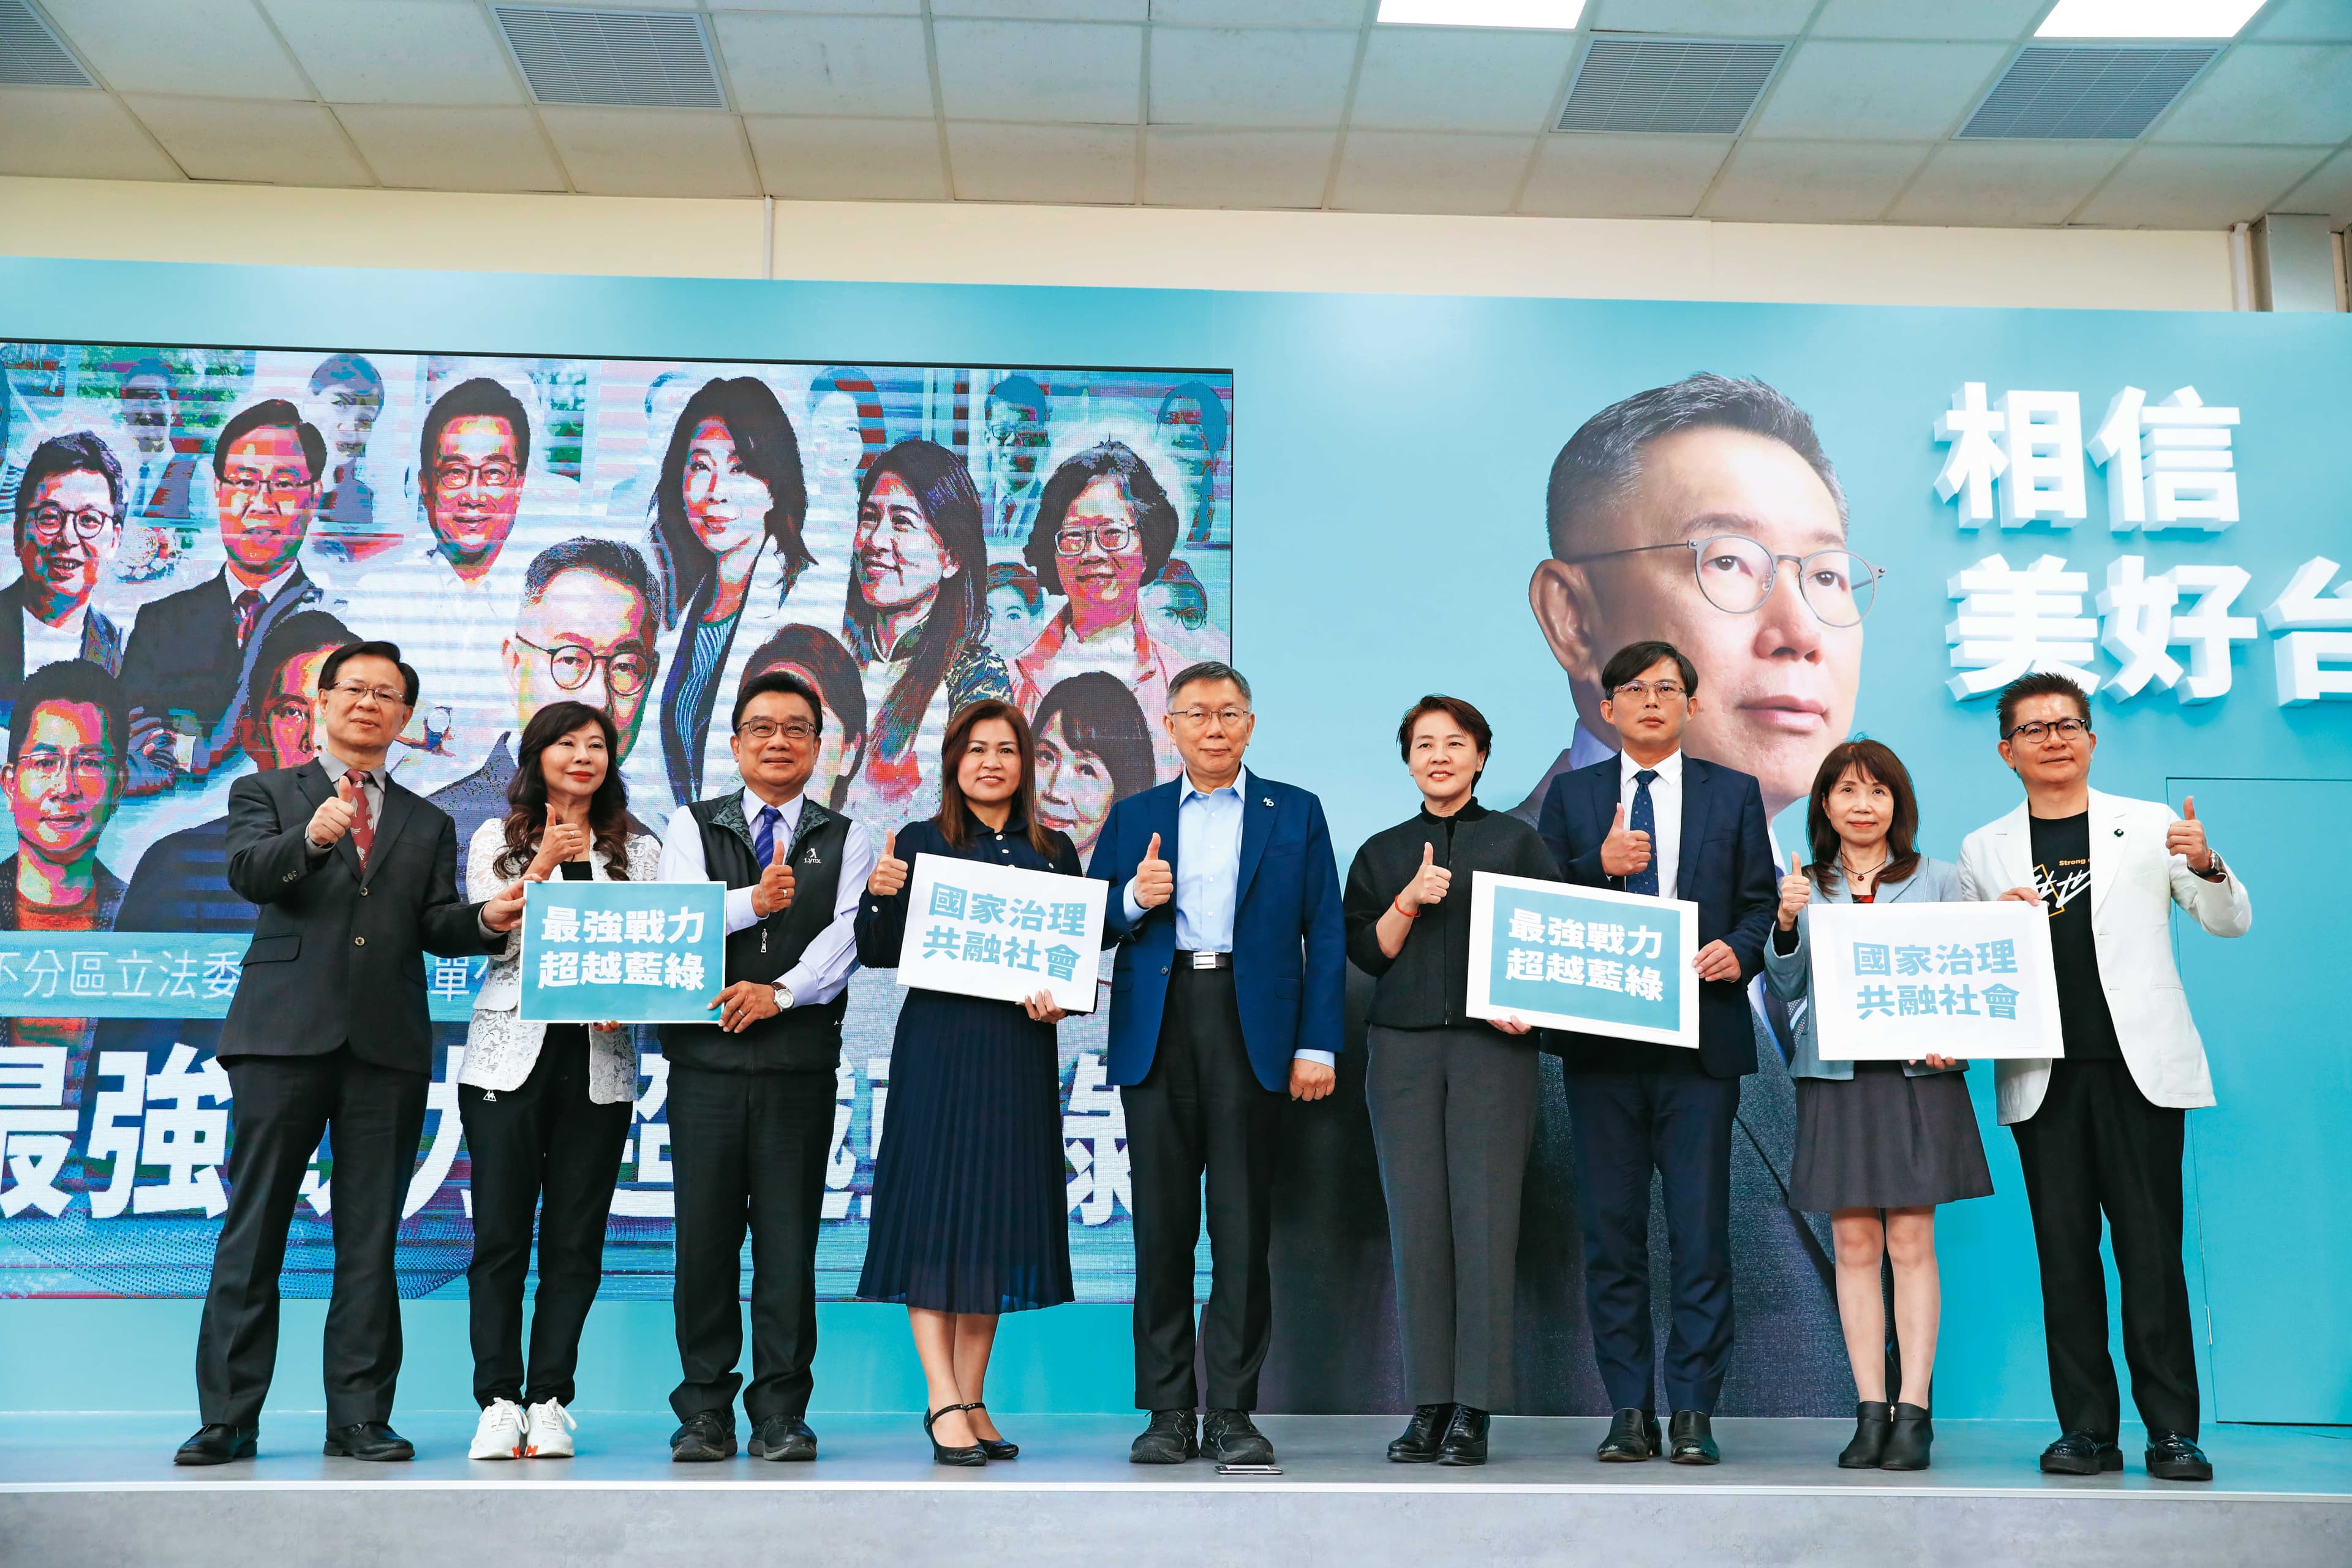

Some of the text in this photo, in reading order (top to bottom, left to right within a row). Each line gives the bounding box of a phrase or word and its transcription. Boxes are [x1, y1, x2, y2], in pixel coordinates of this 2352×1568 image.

[1934, 382, 2241, 532] 相信
[541, 905, 705, 944] 最強戰力
[929, 882, 1087, 938] 國家治理
[1508, 908, 1662, 959] 最強戰力
[537, 951, 705, 991] 超越藍綠
[922, 925, 1082, 982] 共融社會
[1505, 948, 1664, 1003] 超越藍綠
[1853, 938, 2019, 976] 國家治理
[1856, 983, 2020, 1020] 共融社會
